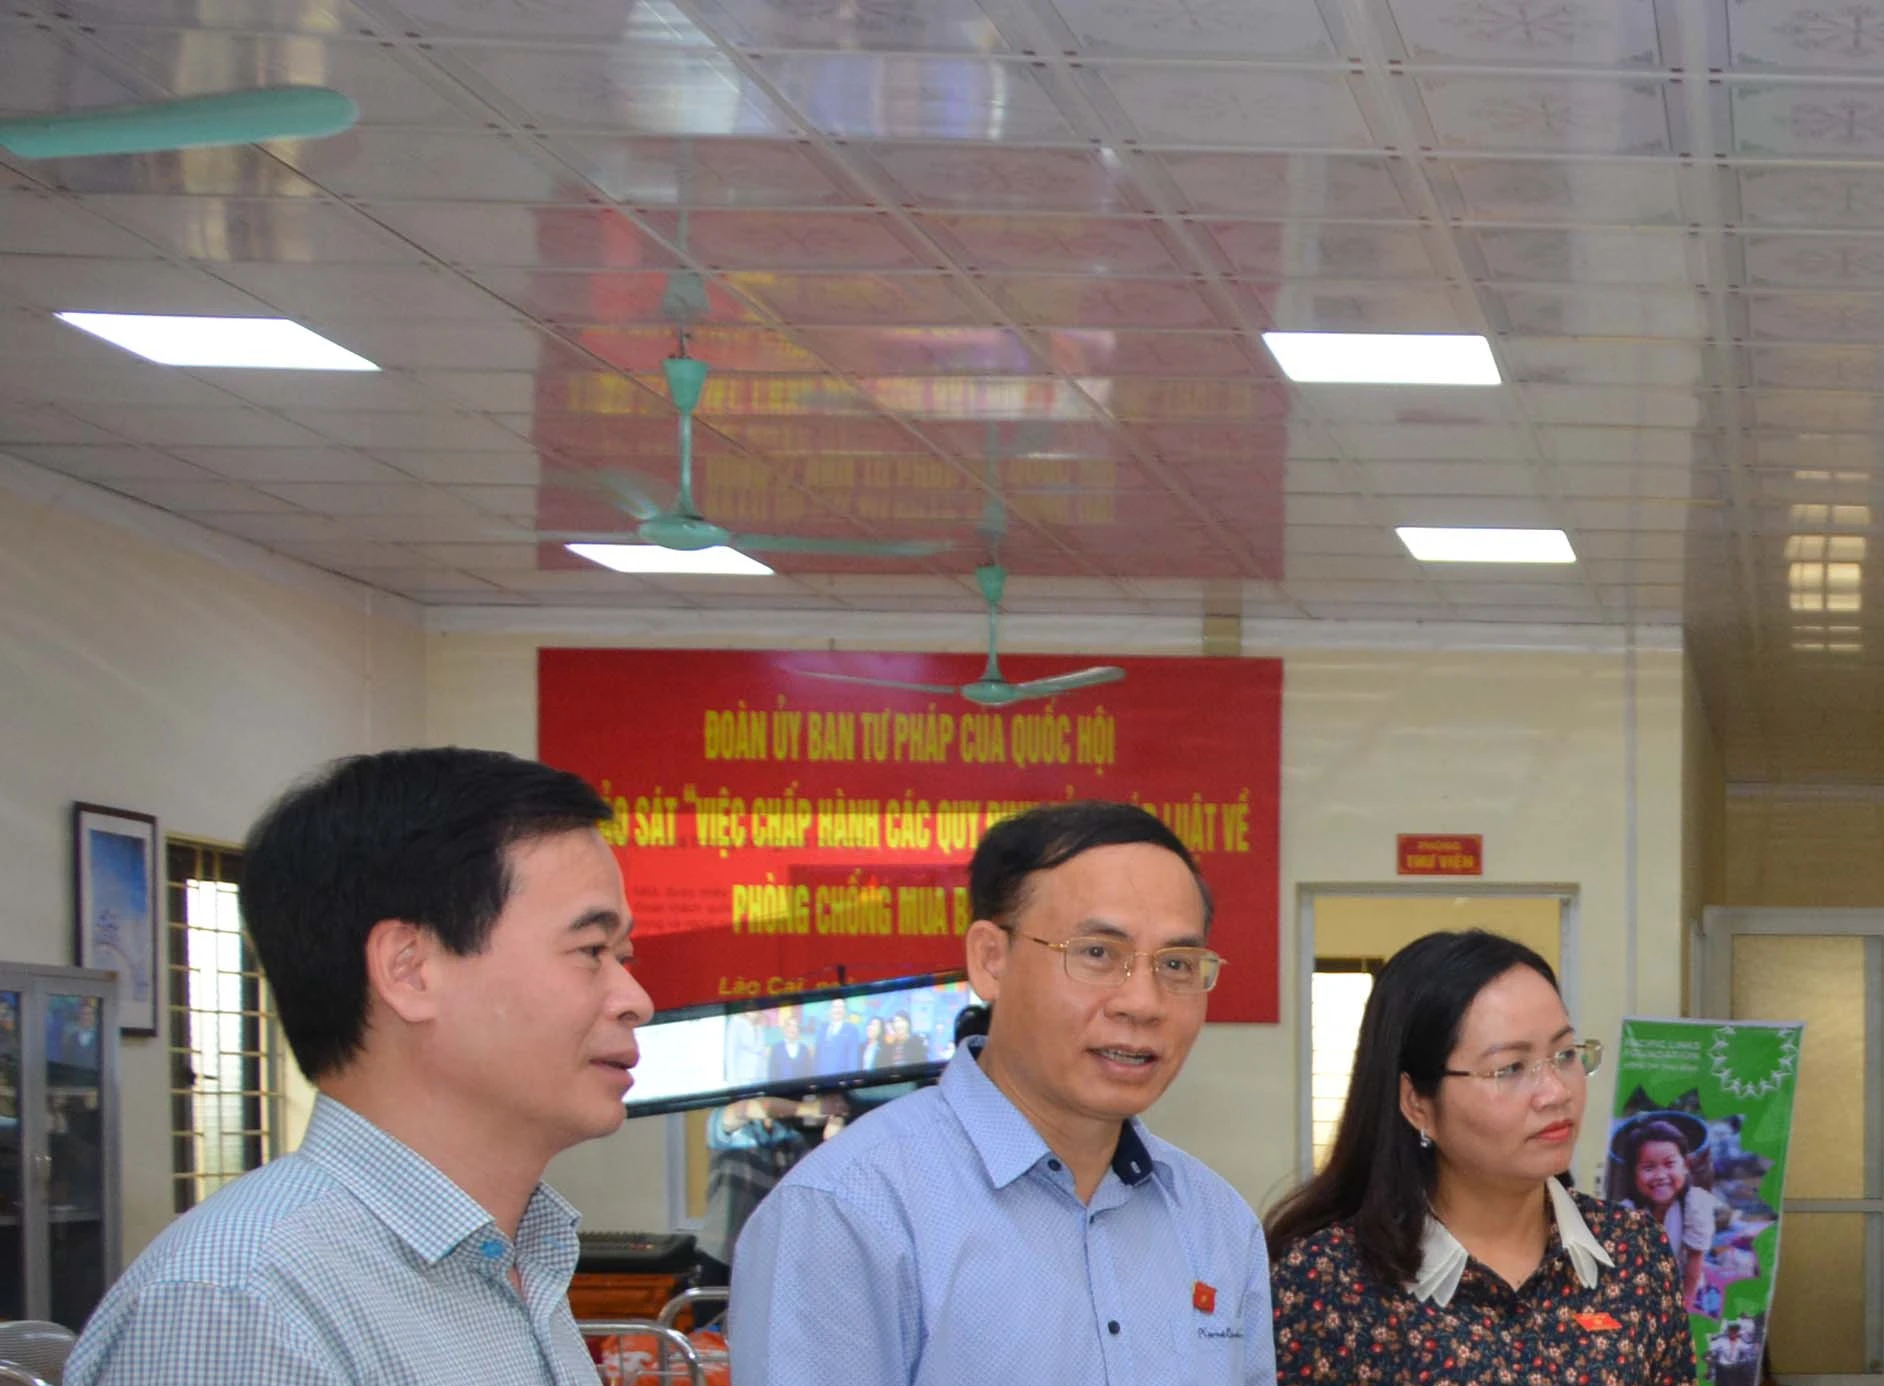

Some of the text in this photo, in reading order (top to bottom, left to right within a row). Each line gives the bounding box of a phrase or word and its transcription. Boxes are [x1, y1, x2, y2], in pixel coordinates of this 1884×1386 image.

[807, 711, 856, 762] BAN
[894, 703, 954, 762] PHÁP
[1011, 698, 1072, 768] QUỐC
[1077, 705, 1116, 776] HỘI
[634, 786, 677, 847] SÁT
[817, 788, 880, 848] HÀNH
[885, 788, 931, 849] CÁC
[937, 799, 981, 854] QUY
[732, 871, 810, 934] PHÒNG
[897, 887, 947, 935] MUA
